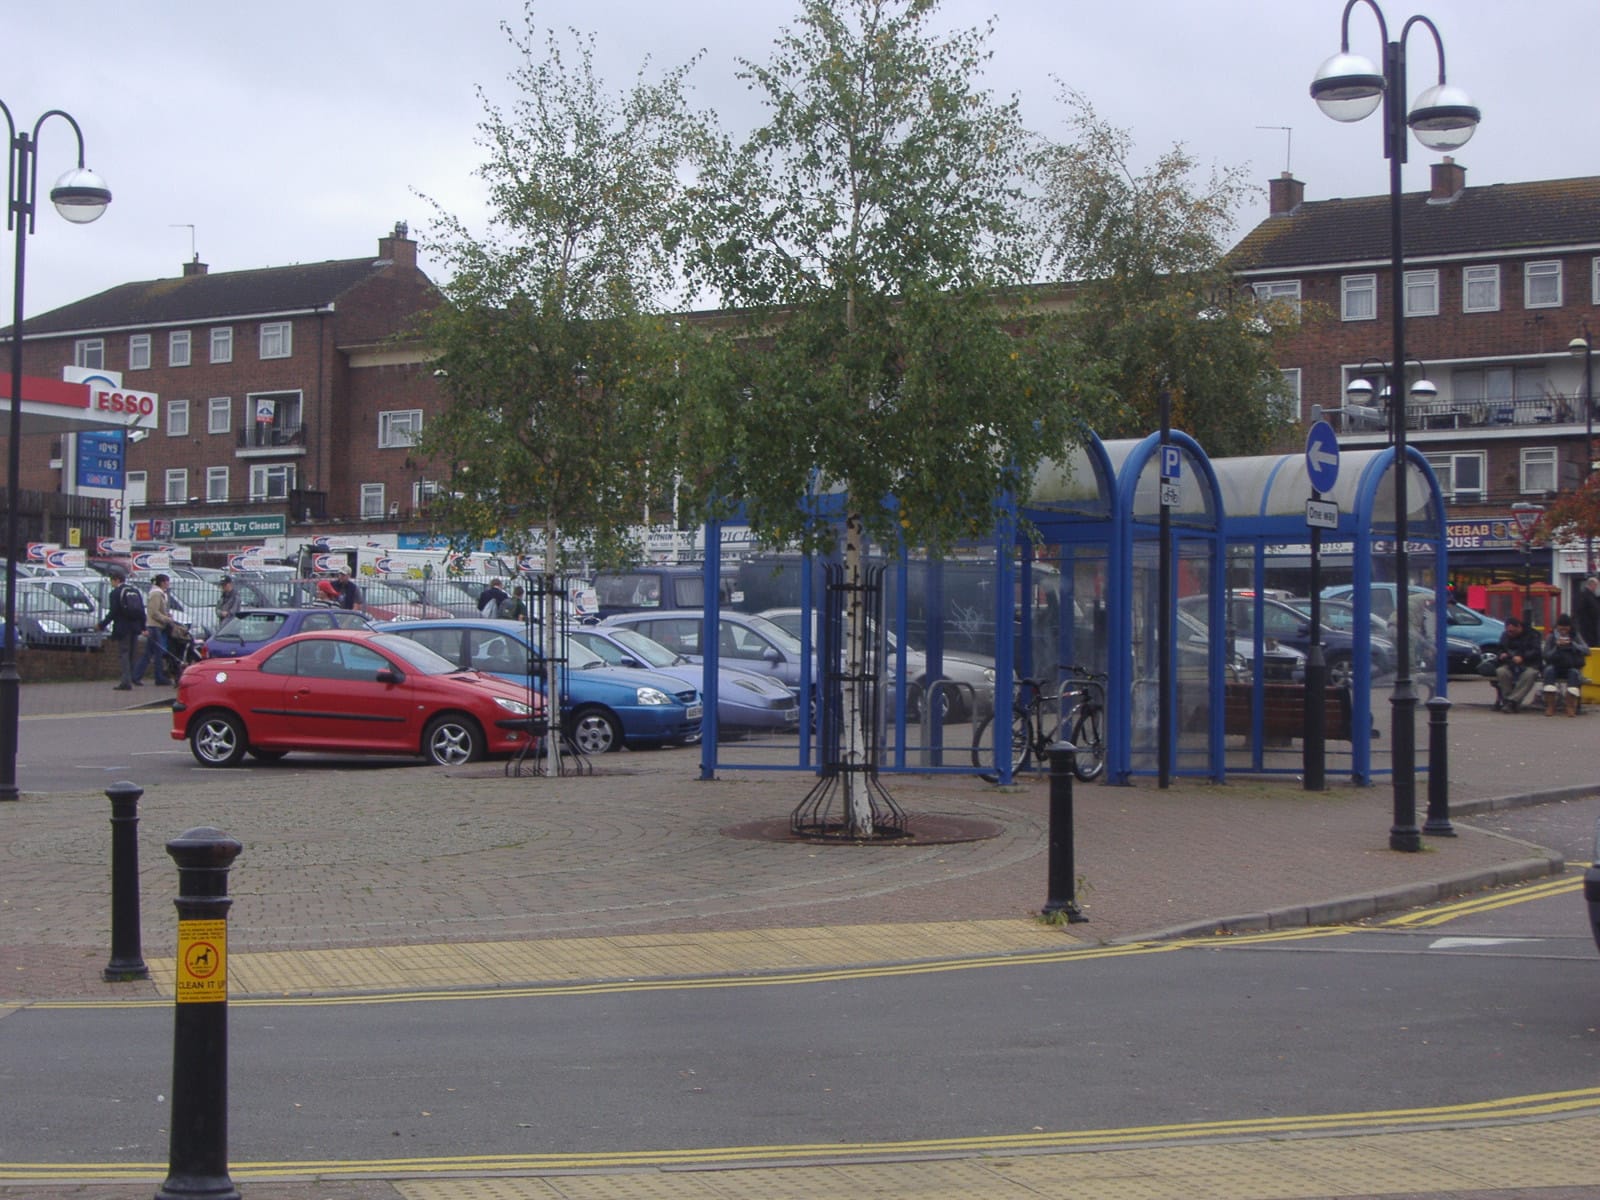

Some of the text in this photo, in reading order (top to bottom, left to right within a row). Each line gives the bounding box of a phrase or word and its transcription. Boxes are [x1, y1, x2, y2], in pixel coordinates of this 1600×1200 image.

[98, 392, 153, 415] ESSO
[1166, 450, 1178, 475] P
[1309, 506, 1336, 524] One way
[233, 521, 247, 532] Dry
[249, 520, 281, 531] Cleaners
[1446, 524, 1489, 536] KEBAB
[1446, 537, 1480, 548] OUSE
[179, 981, 204, 990] CLEAN
[207, 981, 215, 989] IT
